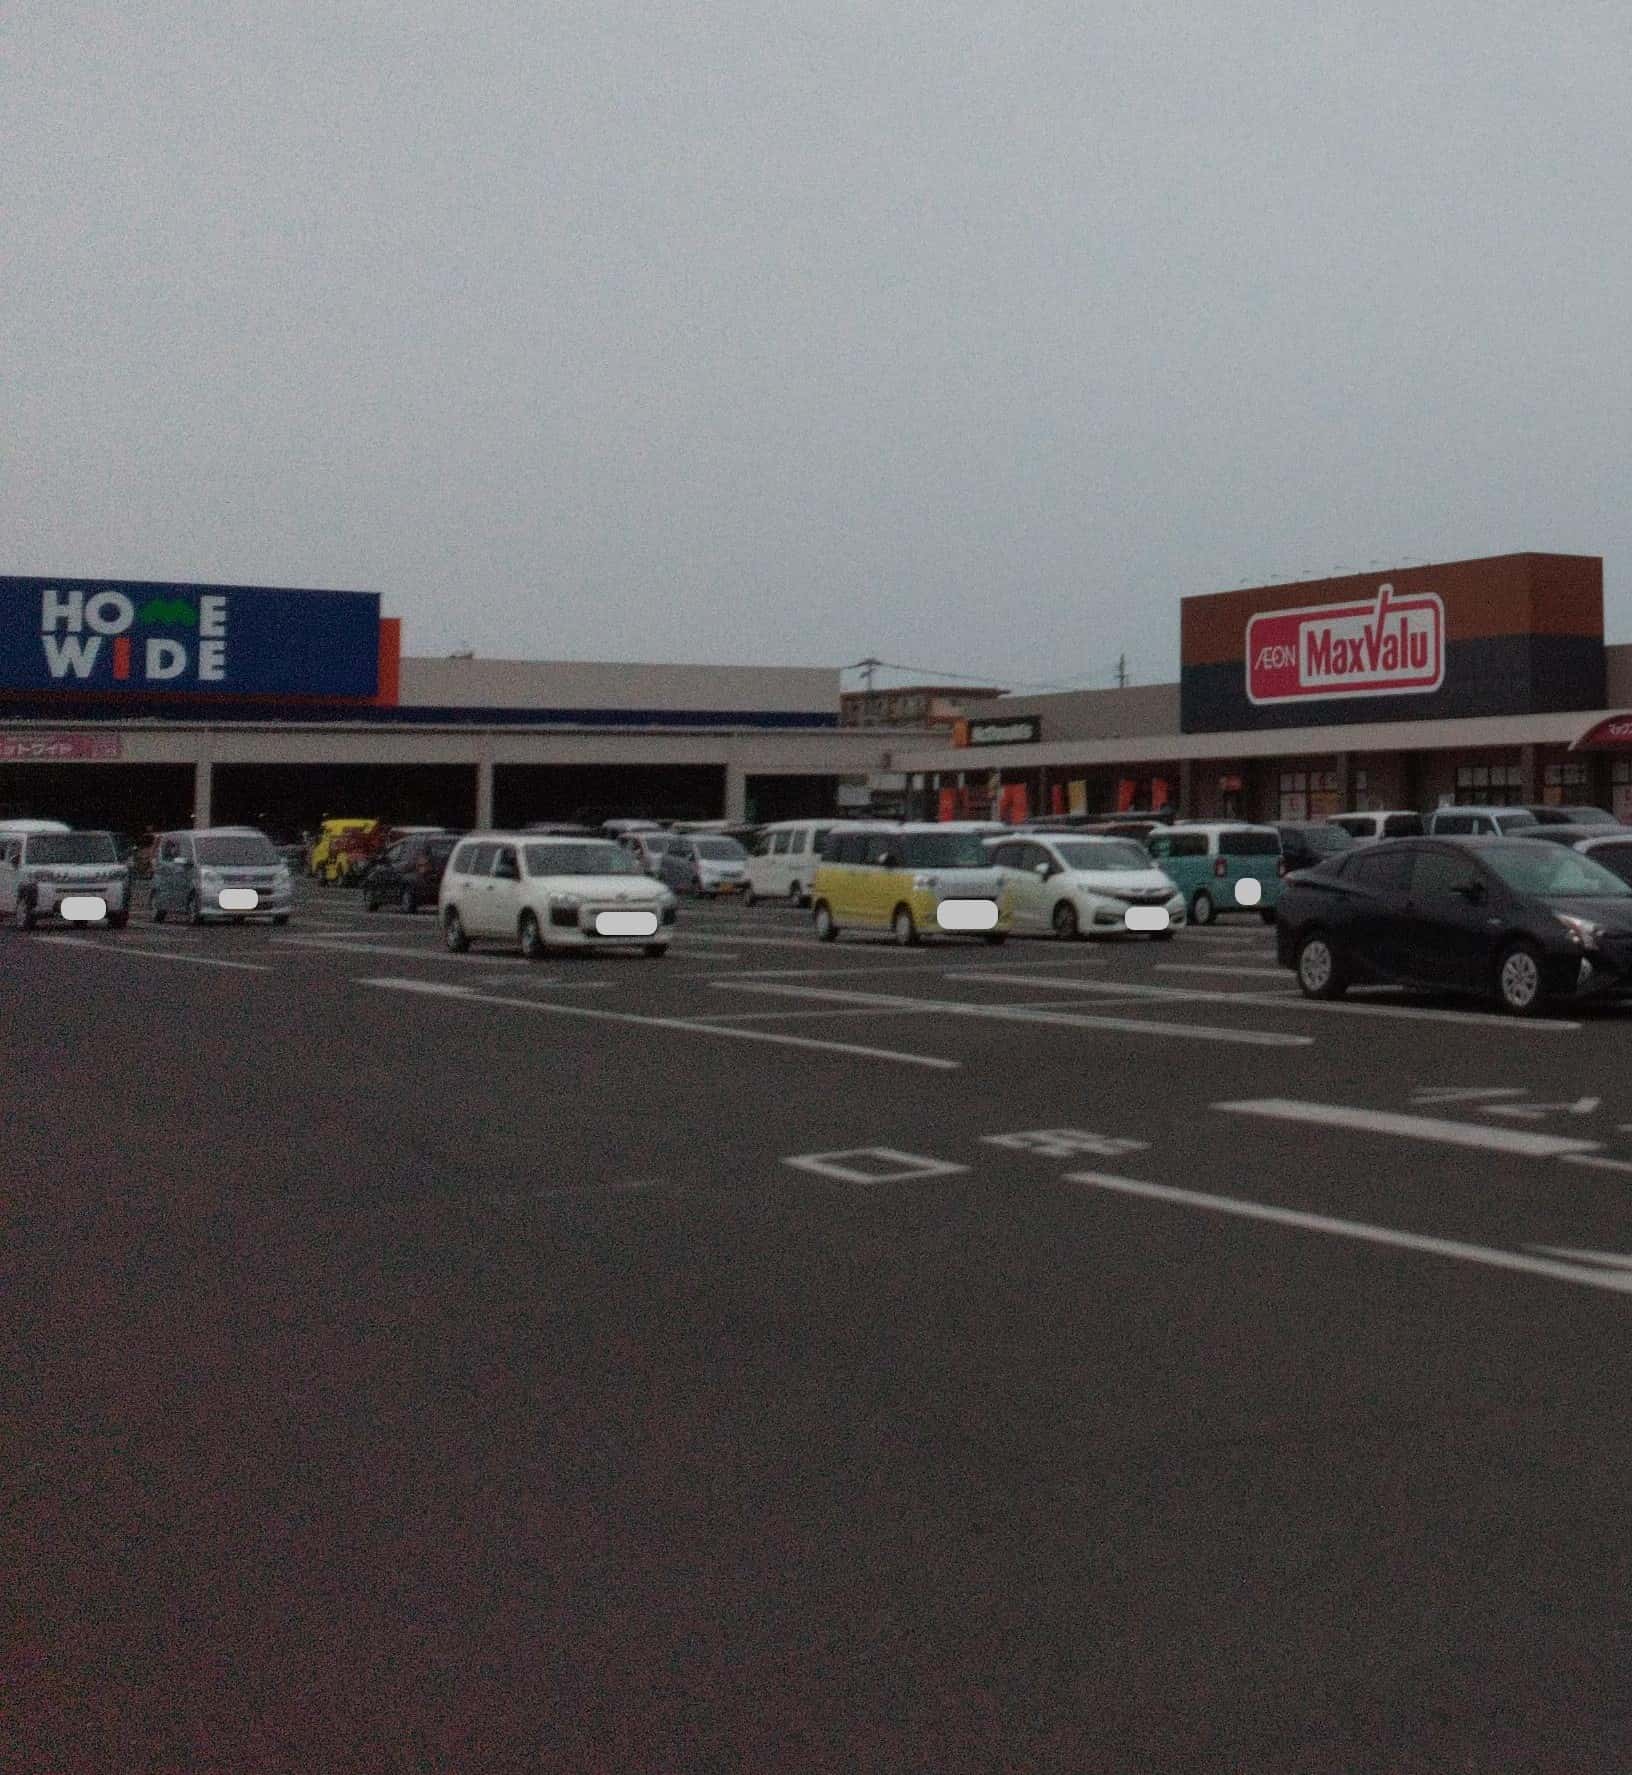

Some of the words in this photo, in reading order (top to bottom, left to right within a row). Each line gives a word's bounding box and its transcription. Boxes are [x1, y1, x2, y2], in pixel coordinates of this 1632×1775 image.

[42, 590, 227, 637] HOME
[1306, 590, 1428, 677] MaxValu
[42, 634, 226, 681] WIDE
